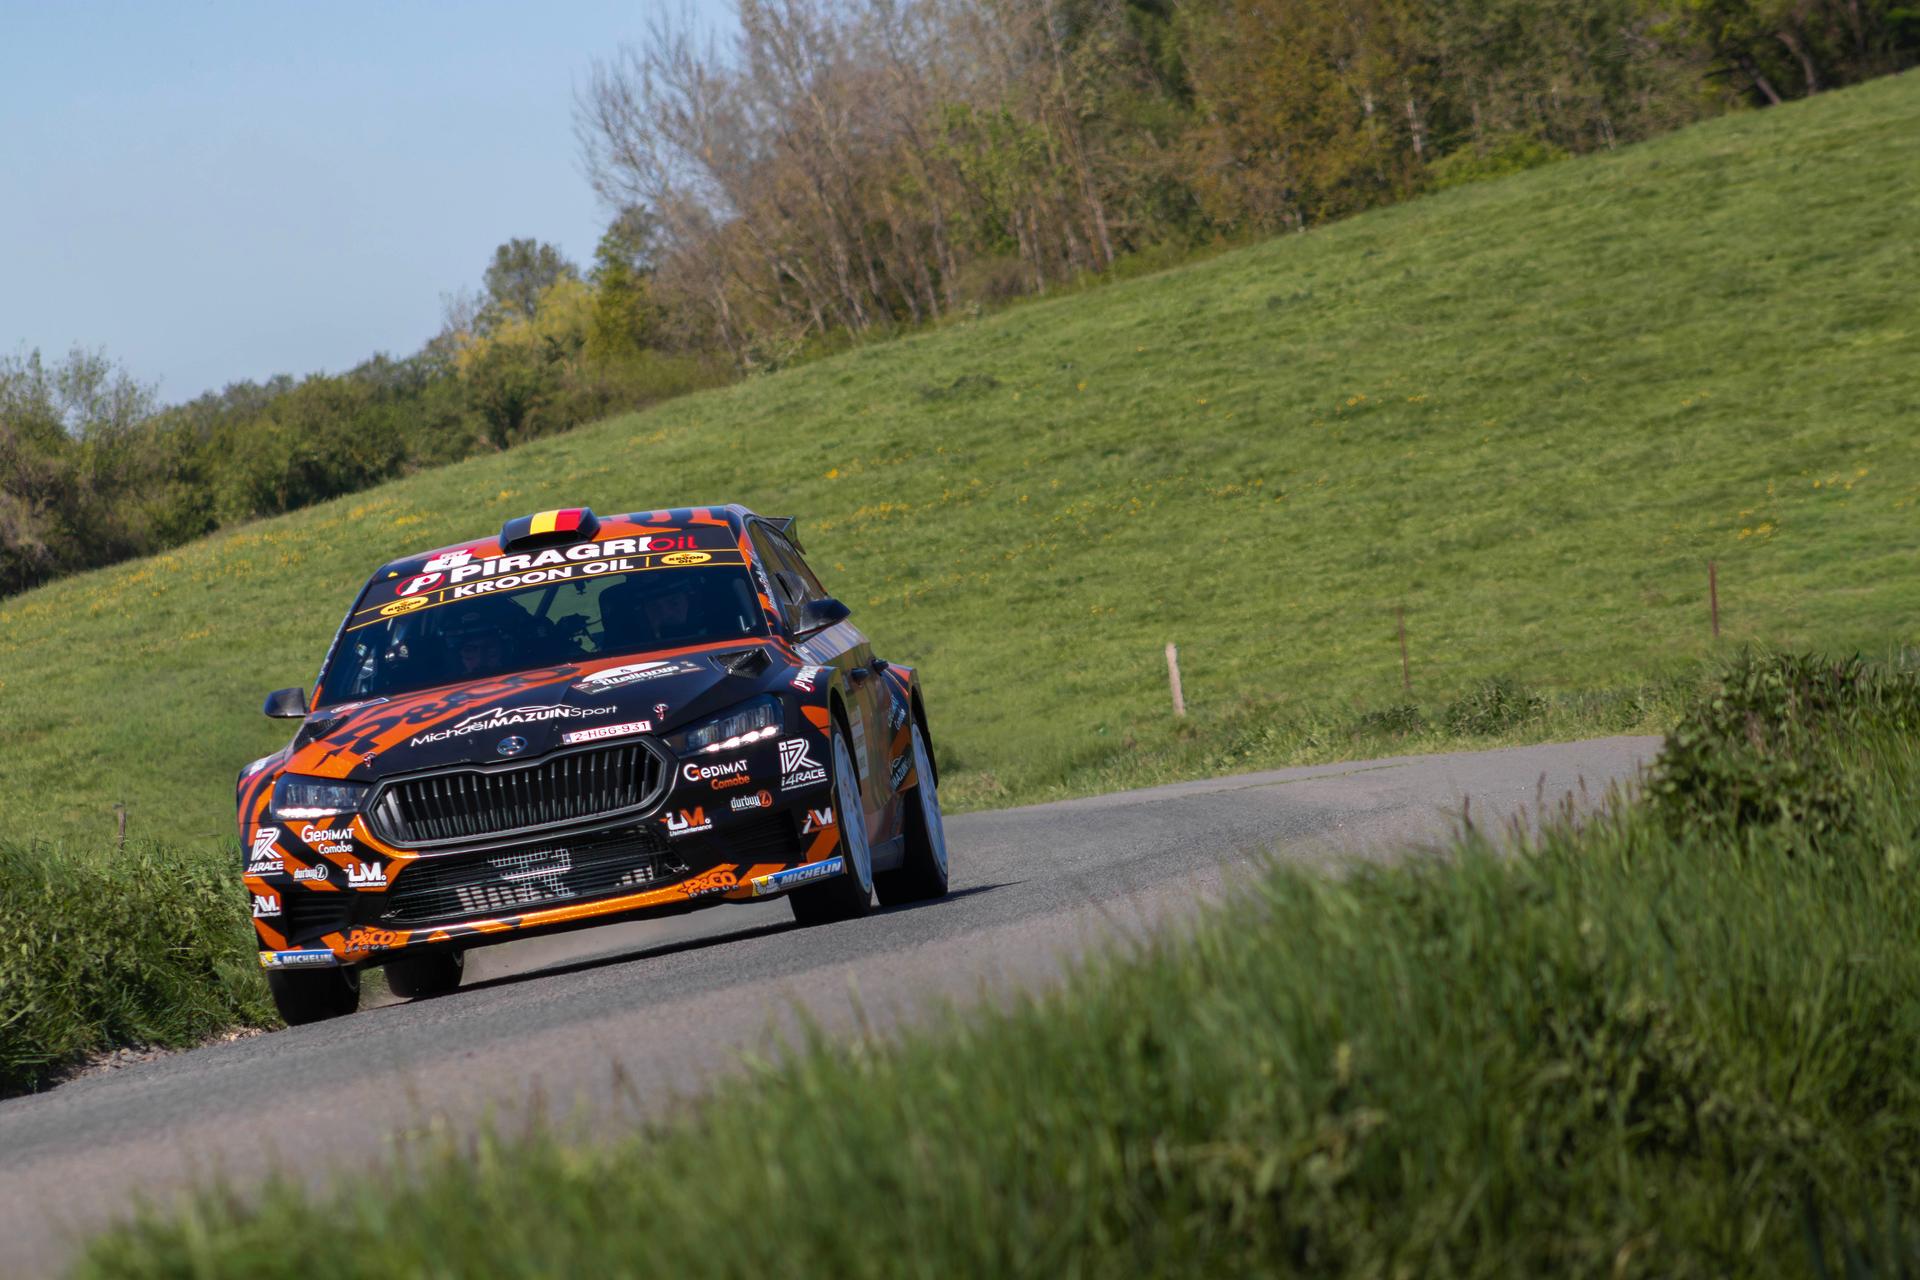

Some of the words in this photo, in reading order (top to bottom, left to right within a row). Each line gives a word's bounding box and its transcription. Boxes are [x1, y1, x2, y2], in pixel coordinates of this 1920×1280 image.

[453, 566, 572, 599] KROON
[583, 558, 634, 574] OIL
[780, 862, 842, 885] MICHELIN
[282, 953, 332, 965] MICHELIN
